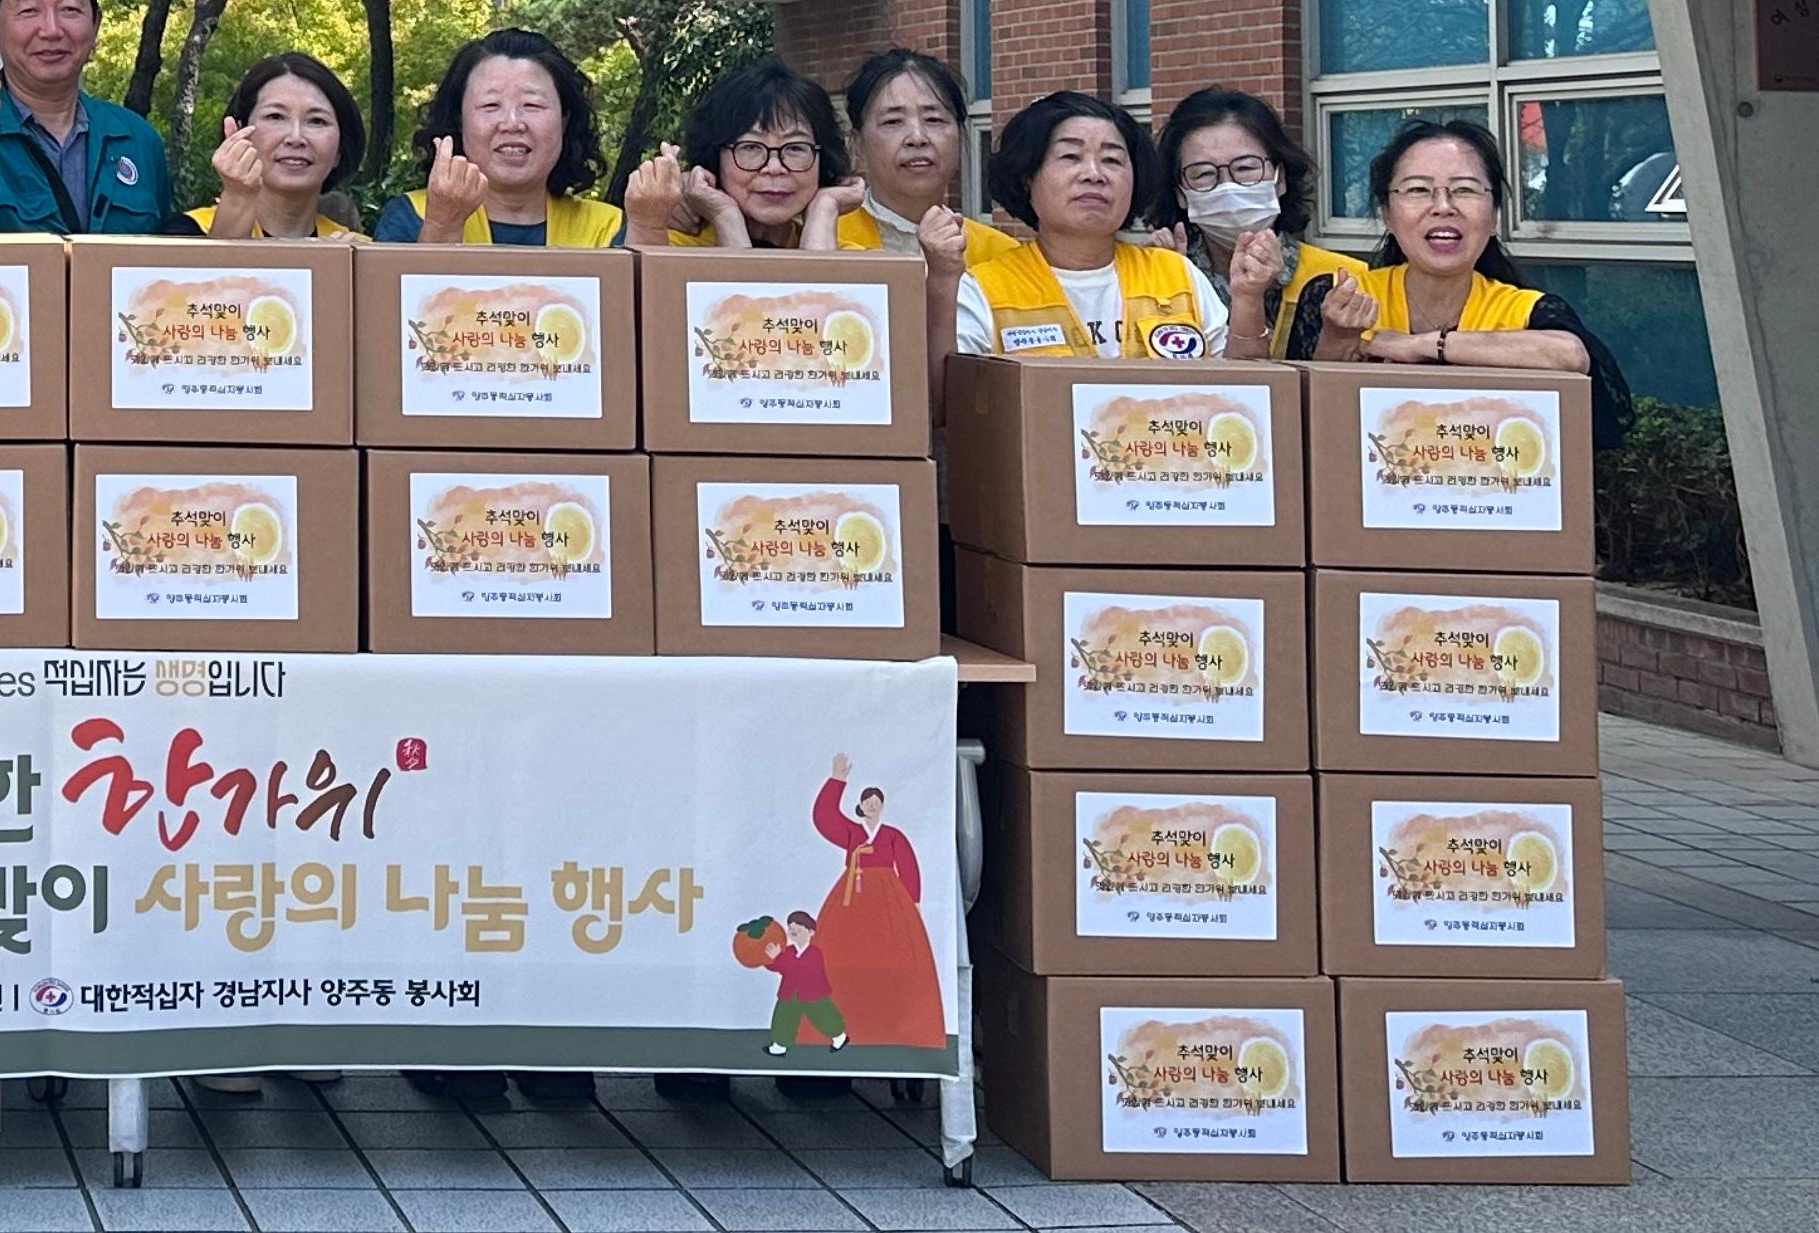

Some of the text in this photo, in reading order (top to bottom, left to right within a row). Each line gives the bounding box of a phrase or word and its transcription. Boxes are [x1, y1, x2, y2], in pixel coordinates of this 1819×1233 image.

[187, 303, 242, 319] 추석맞이
[474, 311, 529, 327] 추석맞이
[164, 324, 271, 340] 사랑의 나눔 행사
[761, 318, 818, 334] 추석맞이
[452, 332, 559, 348] 사랑의 나눔 행사
[739, 339, 848, 355] 사랑의 나눔 행사
[1147, 419, 1202, 435] 추석맞이
[1435, 424, 1490, 440] 추석맞이
[1125, 440, 1232, 457] 사랑의 나눔 행사
[1412, 445, 1520, 461] 사랑의 나눔 행사
[171, 511, 227, 527] 추석맞이
[484, 509, 539, 526] 추석맞이
[773, 519, 830, 535] 추석맞이
[148, 532, 256, 549] 사랑의 나눔 행사
[462, 531, 569, 547] 사랑의 나눔 행사
[751, 540, 860, 557] 사랑의 나눔 행사
[1137, 630, 1192, 648] 추석맞이
[1434, 631, 1489, 648] 추석맞이
[1115, 651, 1222, 670] 사랑의 나눔 행사
[1411, 651, 1518, 670] 사랑의 나눔 행사
[44, 659, 146, 697] 적십자는
[155, 660, 287, 698] 생명입니다
[61, 717, 392, 852] 한가위
[1151, 829, 1206, 846] 추석맞이
[1447, 838, 1503, 855] 추석맞이
[1128, 850, 1236, 868] 사랑의 나눔 행사
[1424, 859, 1533, 876] 사랑의 나눔 행사
[133, 862, 357, 953] 사랑의
[386, 864, 529, 953] 나눔
[550, 860, 705, 955] 행사
[80, 979, 204, 1013] 대한적십자
[212, 977, 312, 1008] 경남지사
[320, 978, 396, 1006] 양주동
[404, 978, 481, 1009] 봉사회
[1175, 1044, 1232, 1061] 추석맞이
[1463, 1046, 1519, 1063] 추석맞이
[1153, 1066, 1263, 1083] 사랑의 나눔 행사
[1440, 1068, 1549, 1086] 사랑의 나눔 행사
